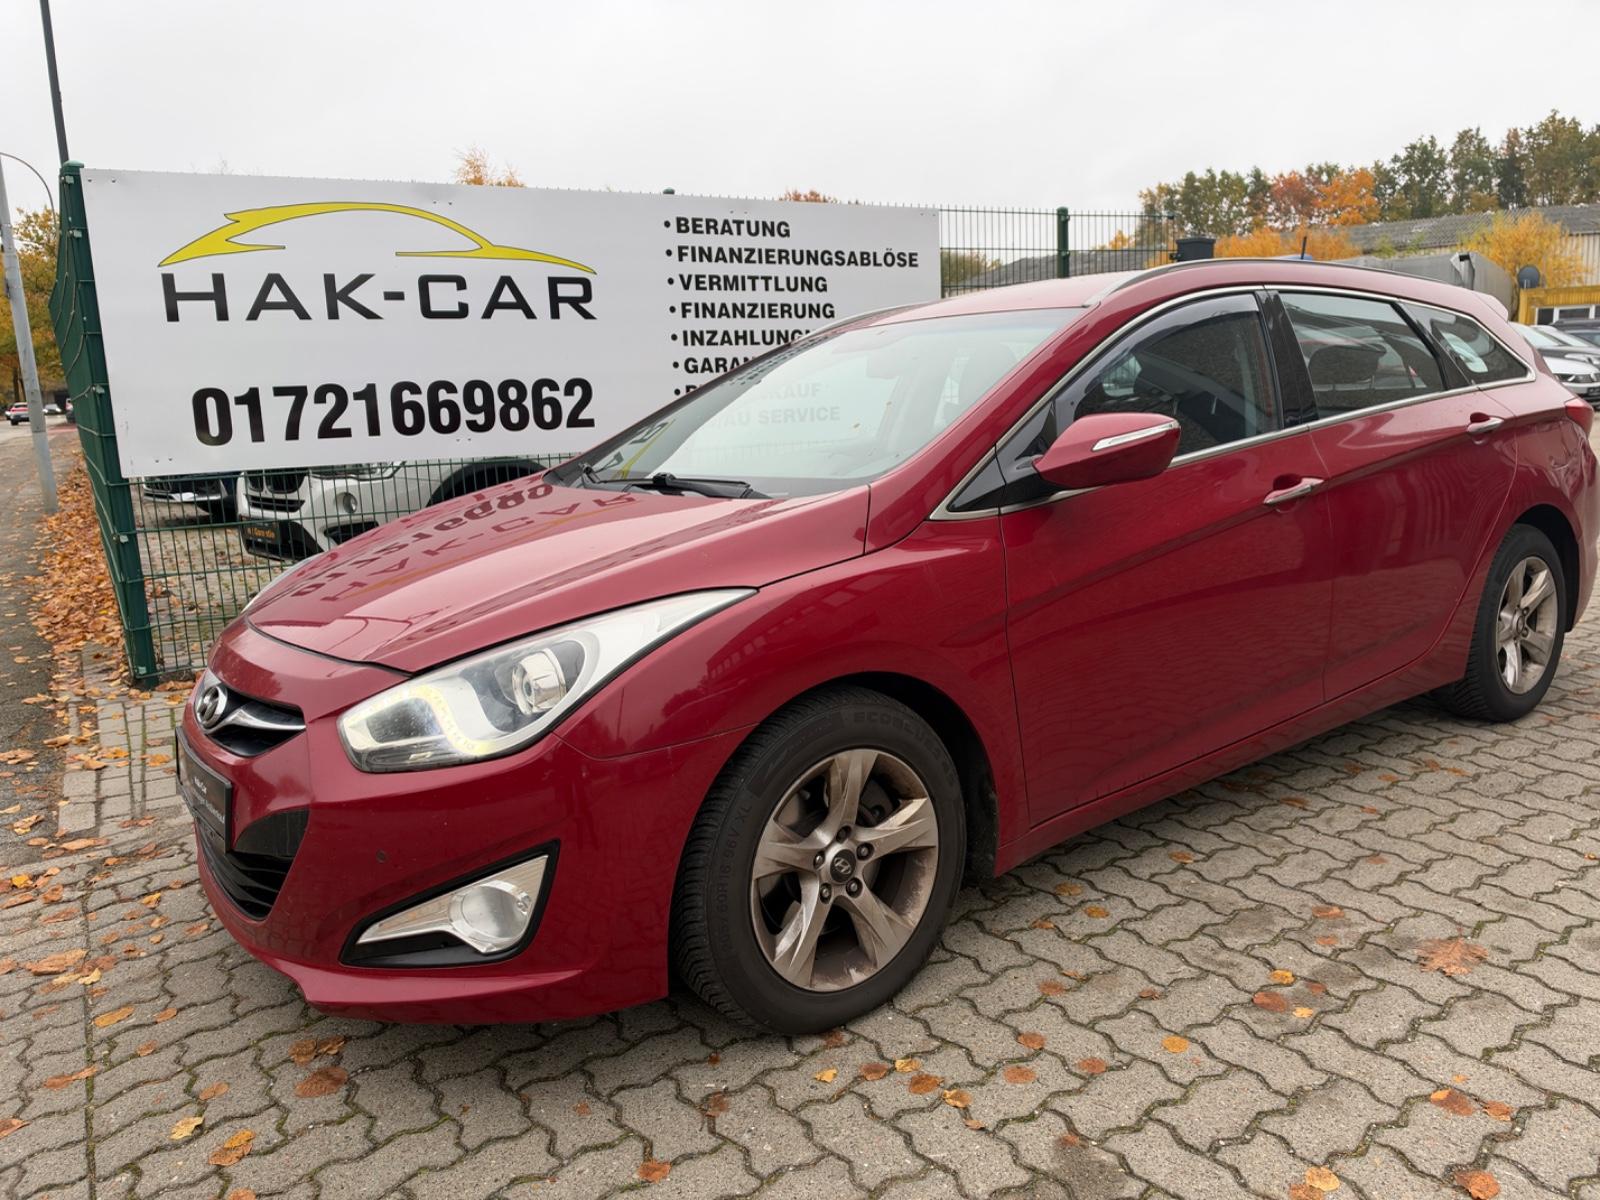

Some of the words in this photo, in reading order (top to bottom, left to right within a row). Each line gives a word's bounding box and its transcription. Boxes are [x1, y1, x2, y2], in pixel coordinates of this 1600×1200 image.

[676, 217, 790, 238] BERATUNG
[677, 246, 919, 268] FINANZIERUNGSABLÖSE
[679, 274, 828, 293] VERMITTLUNG
[160, 272, 597, 323] HAK-CAR
[681, 302, 835, 319] FINANZIERUNG
[683, 329, 811, 346] INZAHLUNG
[684, 357, 750, 374] GARA
[191, 377, 595, 447] 01721669862
[758, 405, 841, 425] SERVICE
